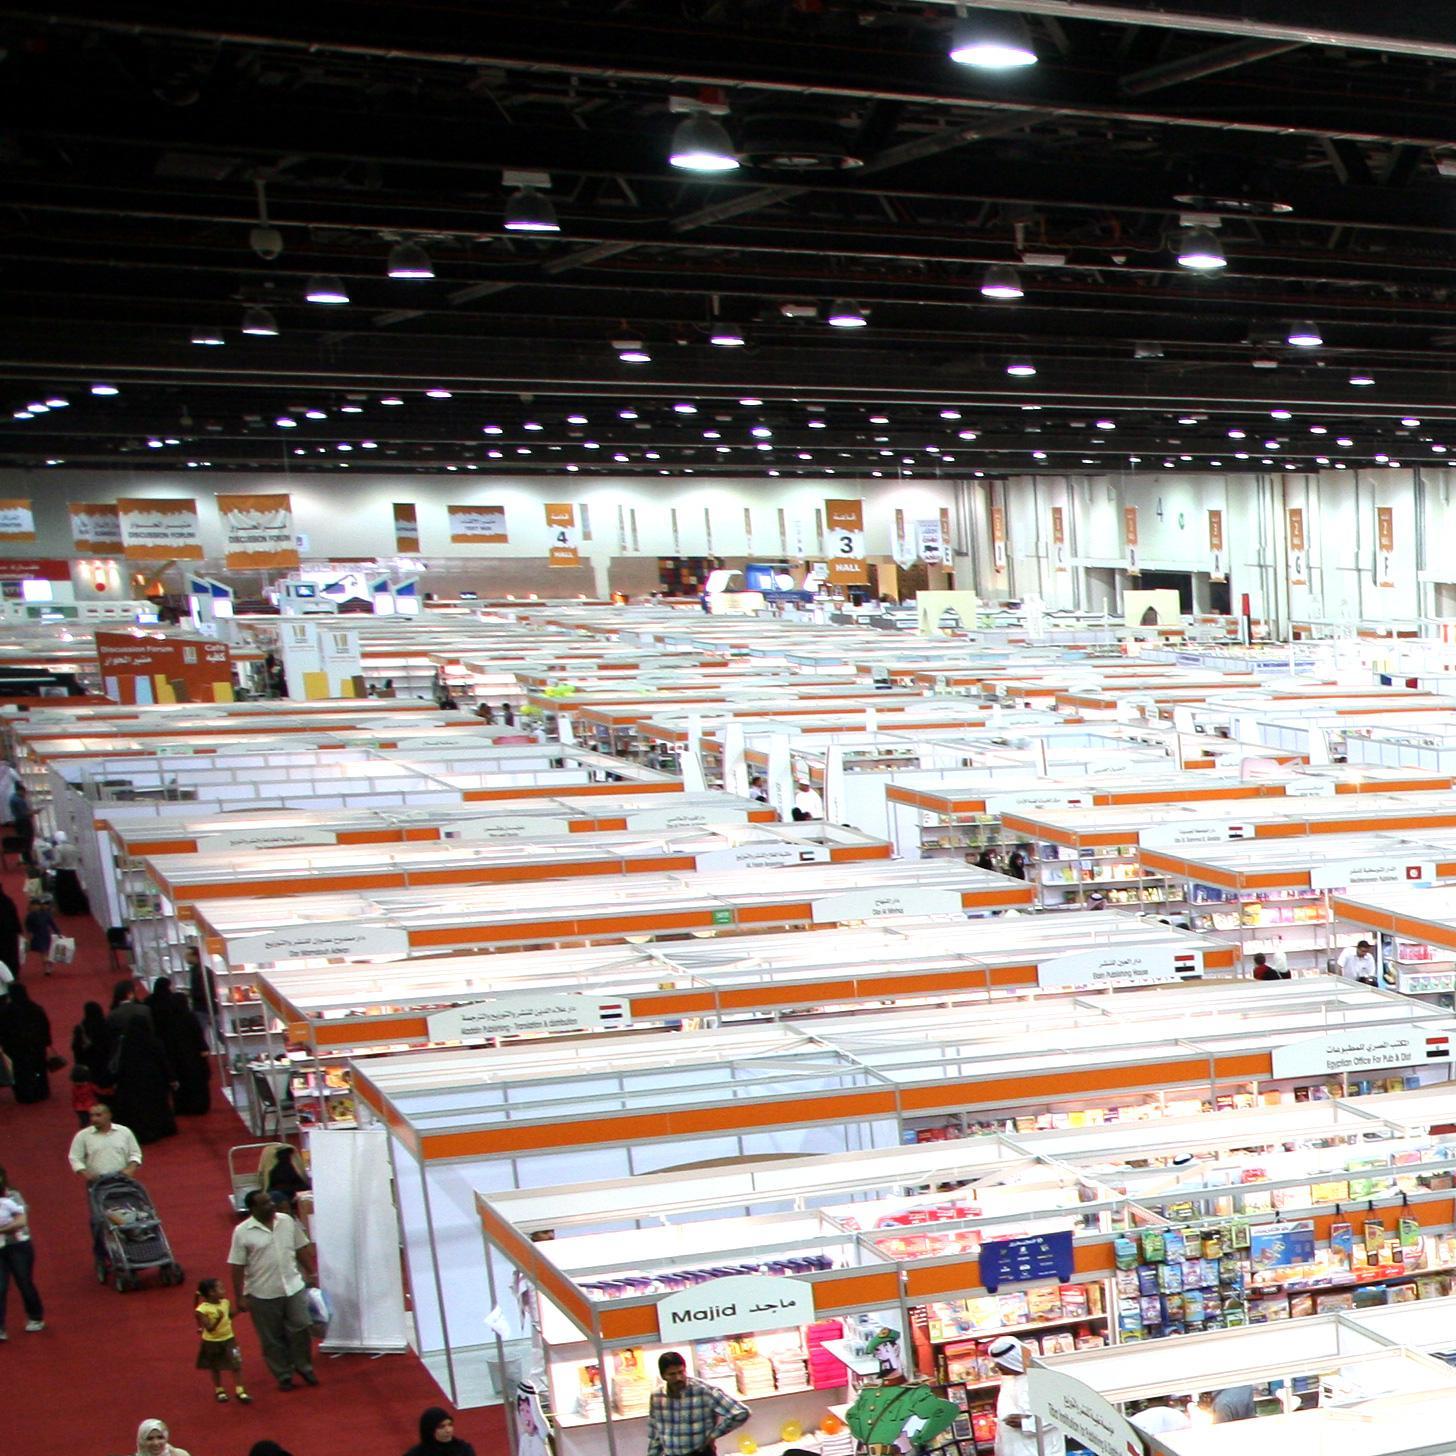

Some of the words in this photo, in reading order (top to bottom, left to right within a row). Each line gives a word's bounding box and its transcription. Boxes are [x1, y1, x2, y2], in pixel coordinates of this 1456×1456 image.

[556, 530, 569, 544] 4
[840, 536, 853, 554] 3
[835, 562, 861, 572] HALL
[101, 645, 145, 653] Discussion
[1326, 1056, 1352, 1070] Egyptian
[1353, 1055, 1371, 1065] Office
[1372, 1055, 1382, 1064] For
[1382, 1054, 1394, 1063] Pub
[1394, 1053, 1400, 1061] &
[1400, 1052, 1412, 1061] Dist
[671, 1303, 737, 1324] Majid
[748, 1299, 796, 1314] ماجد
